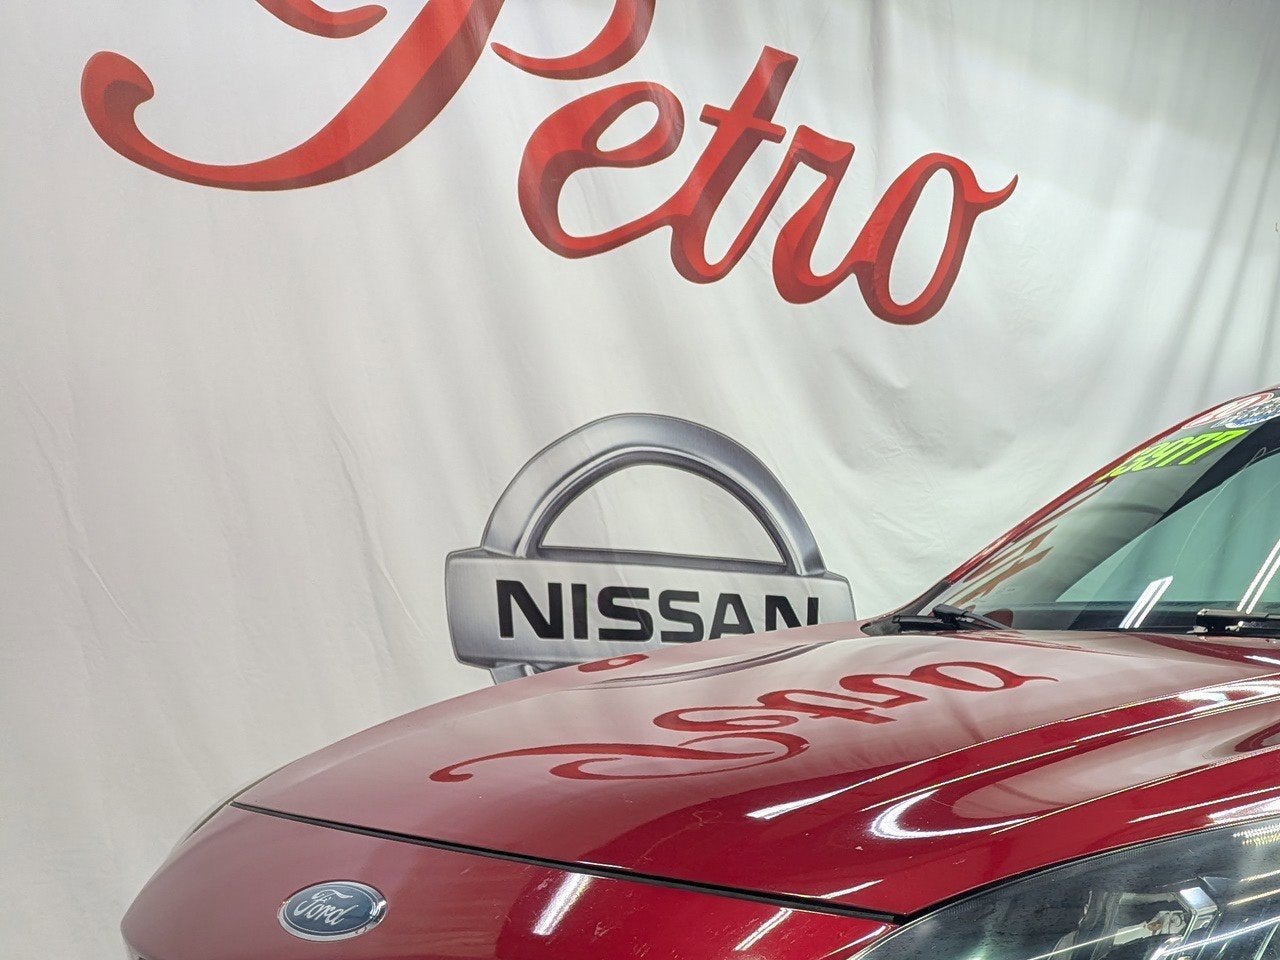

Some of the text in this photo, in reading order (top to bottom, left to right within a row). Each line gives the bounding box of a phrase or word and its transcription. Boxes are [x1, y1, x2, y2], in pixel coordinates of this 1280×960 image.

[80, 0, 1019, 325] Petro
[496, 579, 820, 644] NISSAN
[293, 888, 359, 926] Ford
